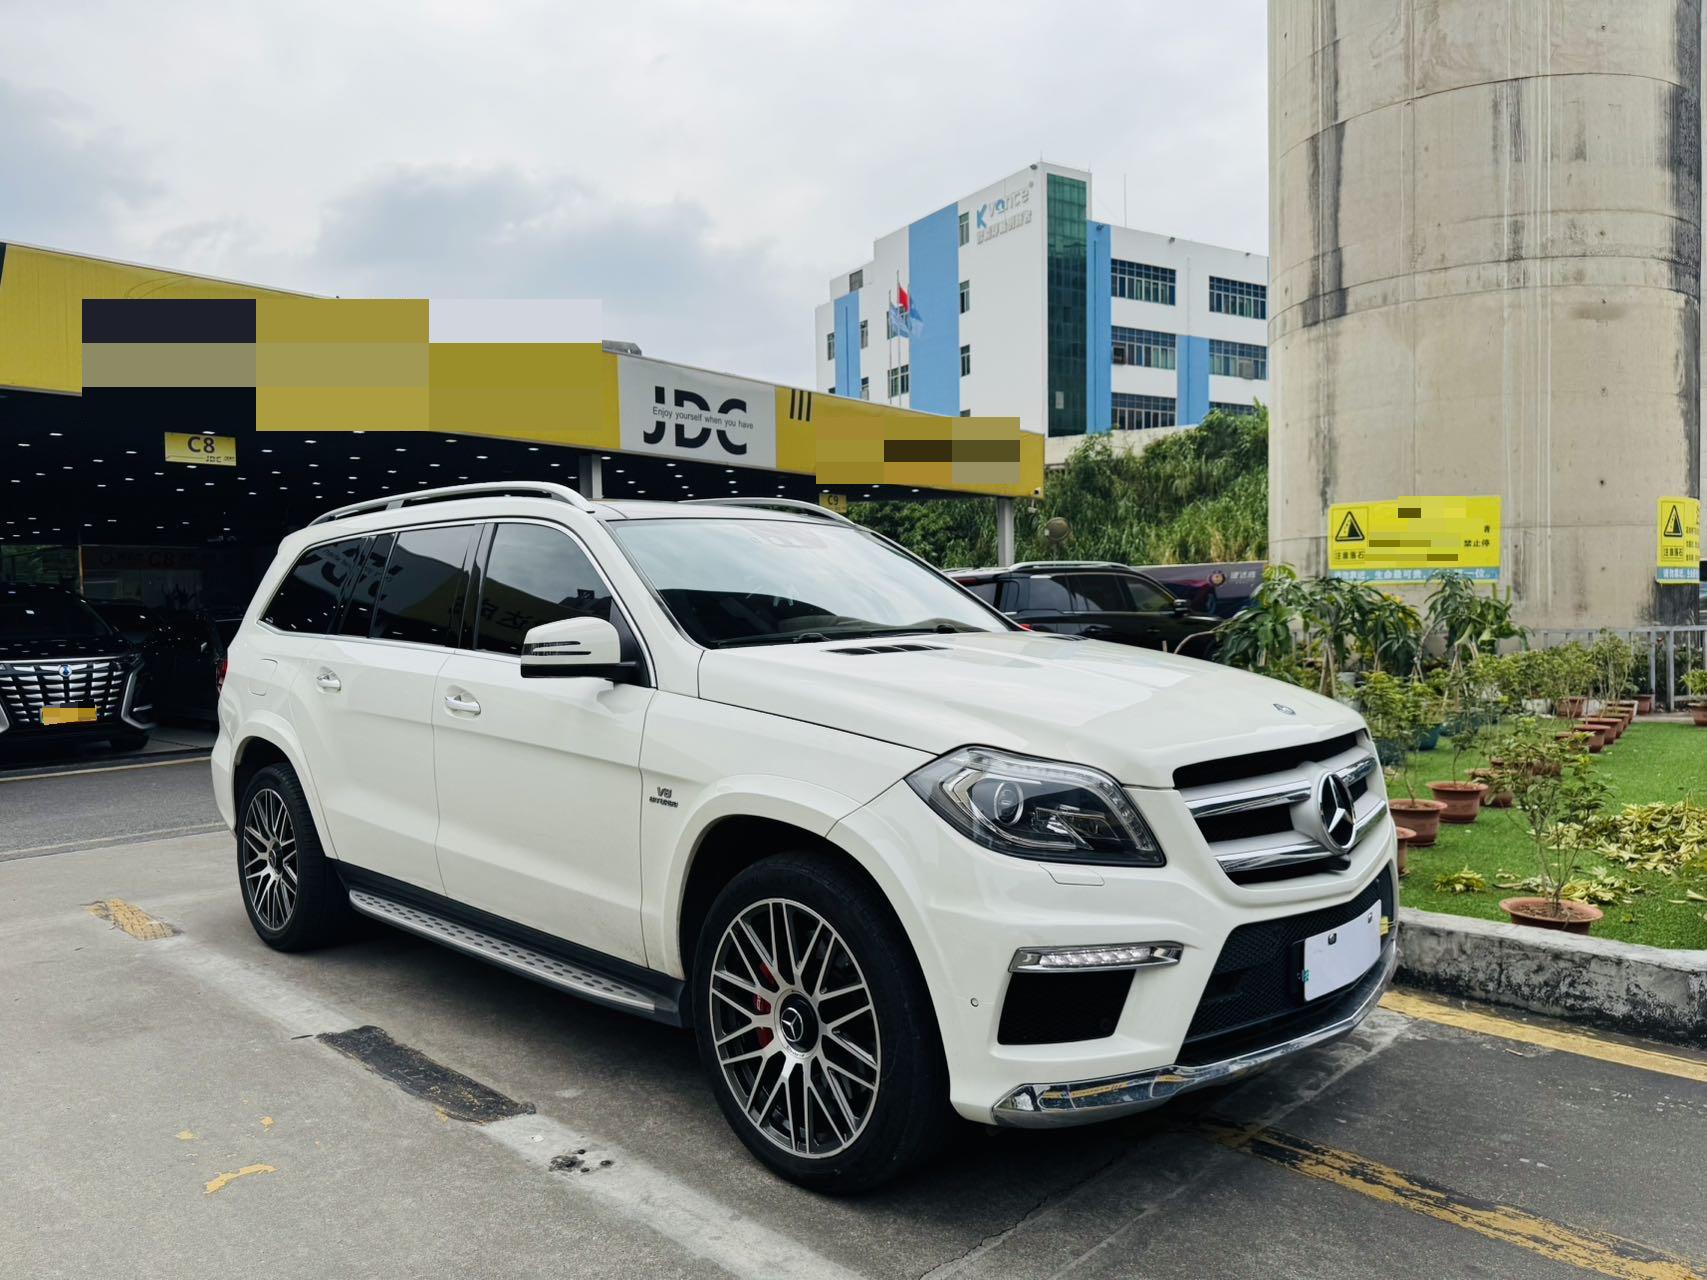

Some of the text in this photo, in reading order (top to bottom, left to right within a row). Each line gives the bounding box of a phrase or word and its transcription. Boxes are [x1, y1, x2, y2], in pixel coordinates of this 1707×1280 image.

[643, 385, 747, 456] JDC
[652, 406, 754, 430] Enjoy yourself when you have
[187, 436, 215, 453] C8
[827, 495, 839, 505] C9
